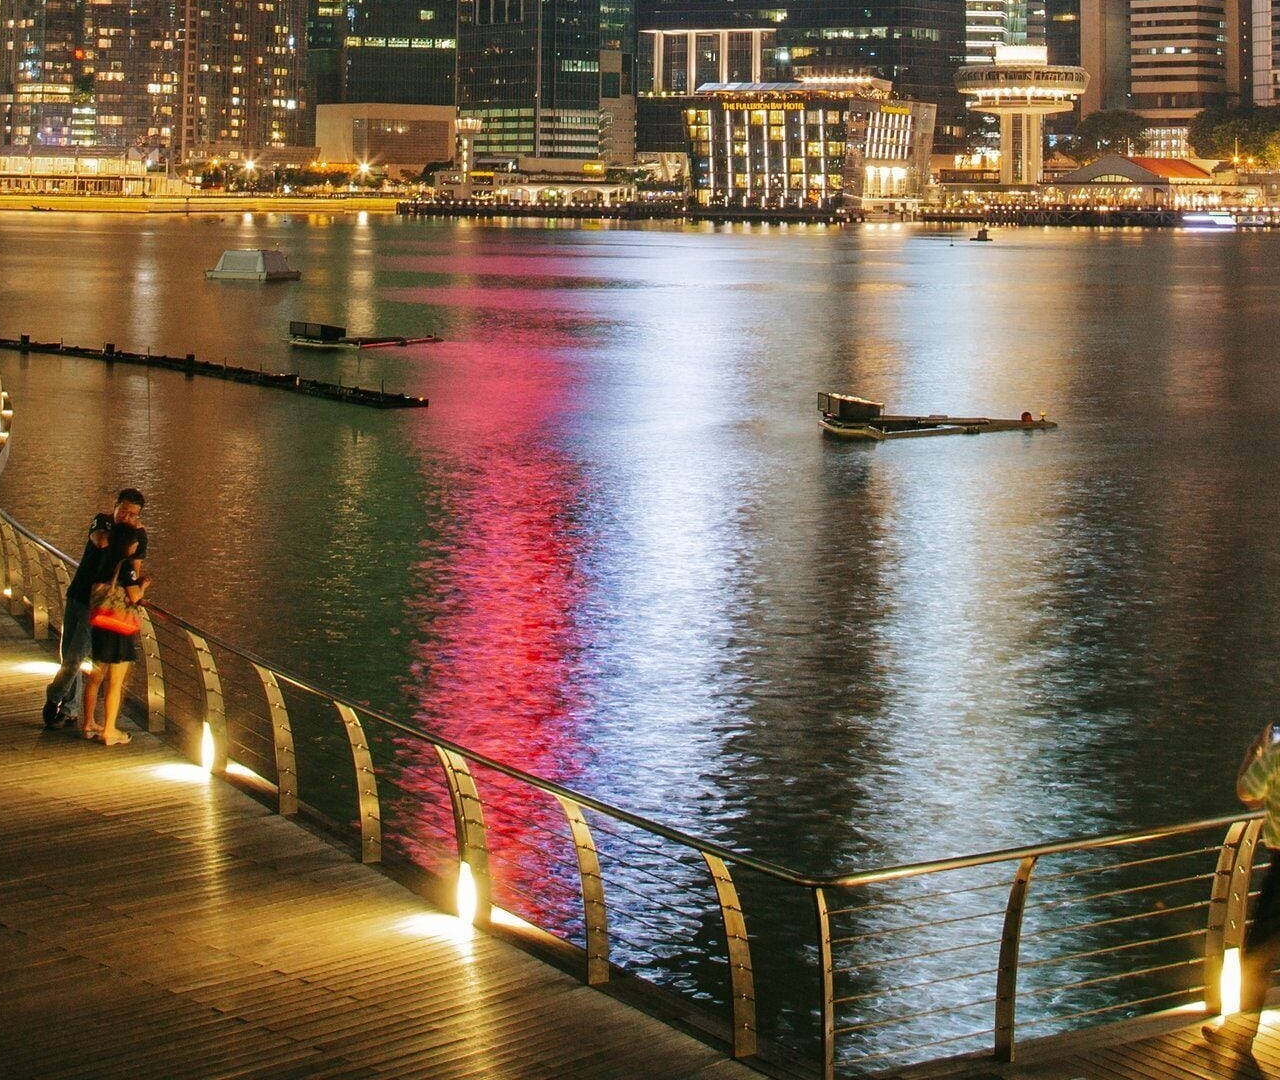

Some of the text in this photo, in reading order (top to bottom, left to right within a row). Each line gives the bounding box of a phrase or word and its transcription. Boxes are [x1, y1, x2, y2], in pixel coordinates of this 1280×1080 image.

[722, 102, 805, 110] THE FULLERTON BAY HOTEL
